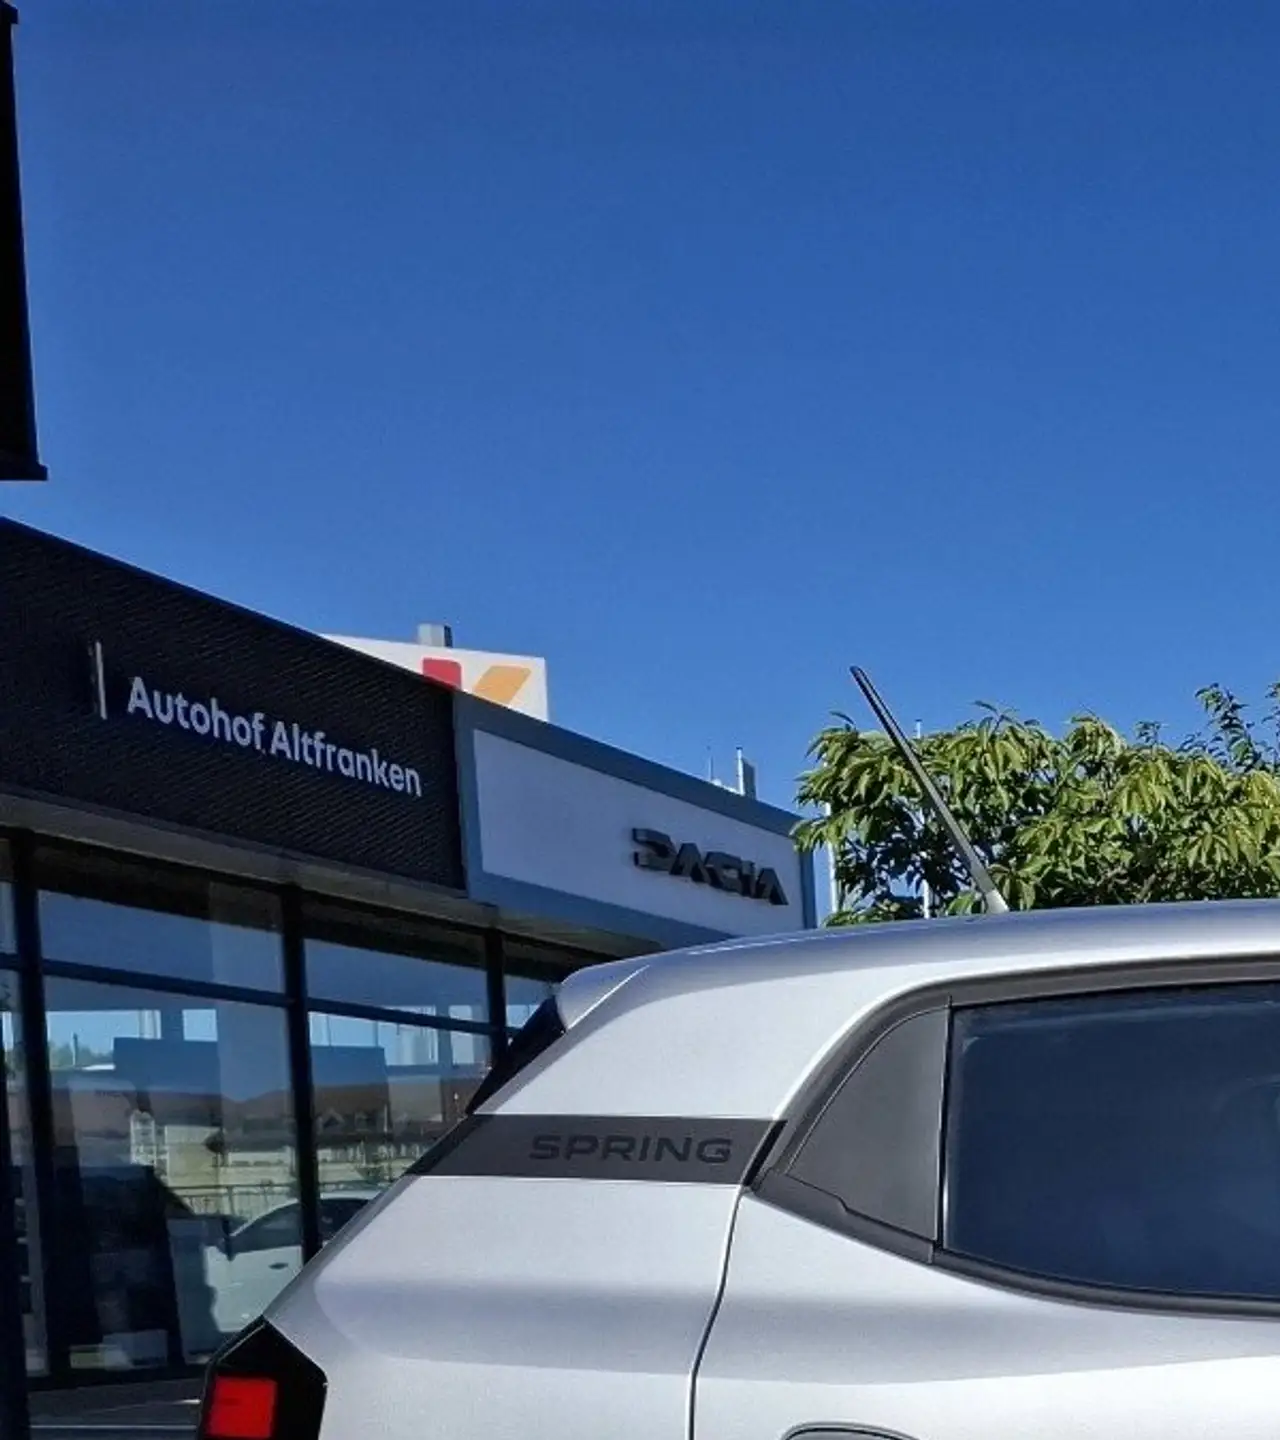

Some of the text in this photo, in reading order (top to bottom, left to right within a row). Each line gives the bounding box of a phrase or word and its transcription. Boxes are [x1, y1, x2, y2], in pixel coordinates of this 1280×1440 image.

[127, 676, 422, 797] Autohof Altfranken
[632, 828, 789, 905] DACIA
[529, 1134, 732, 1163] SPRING
